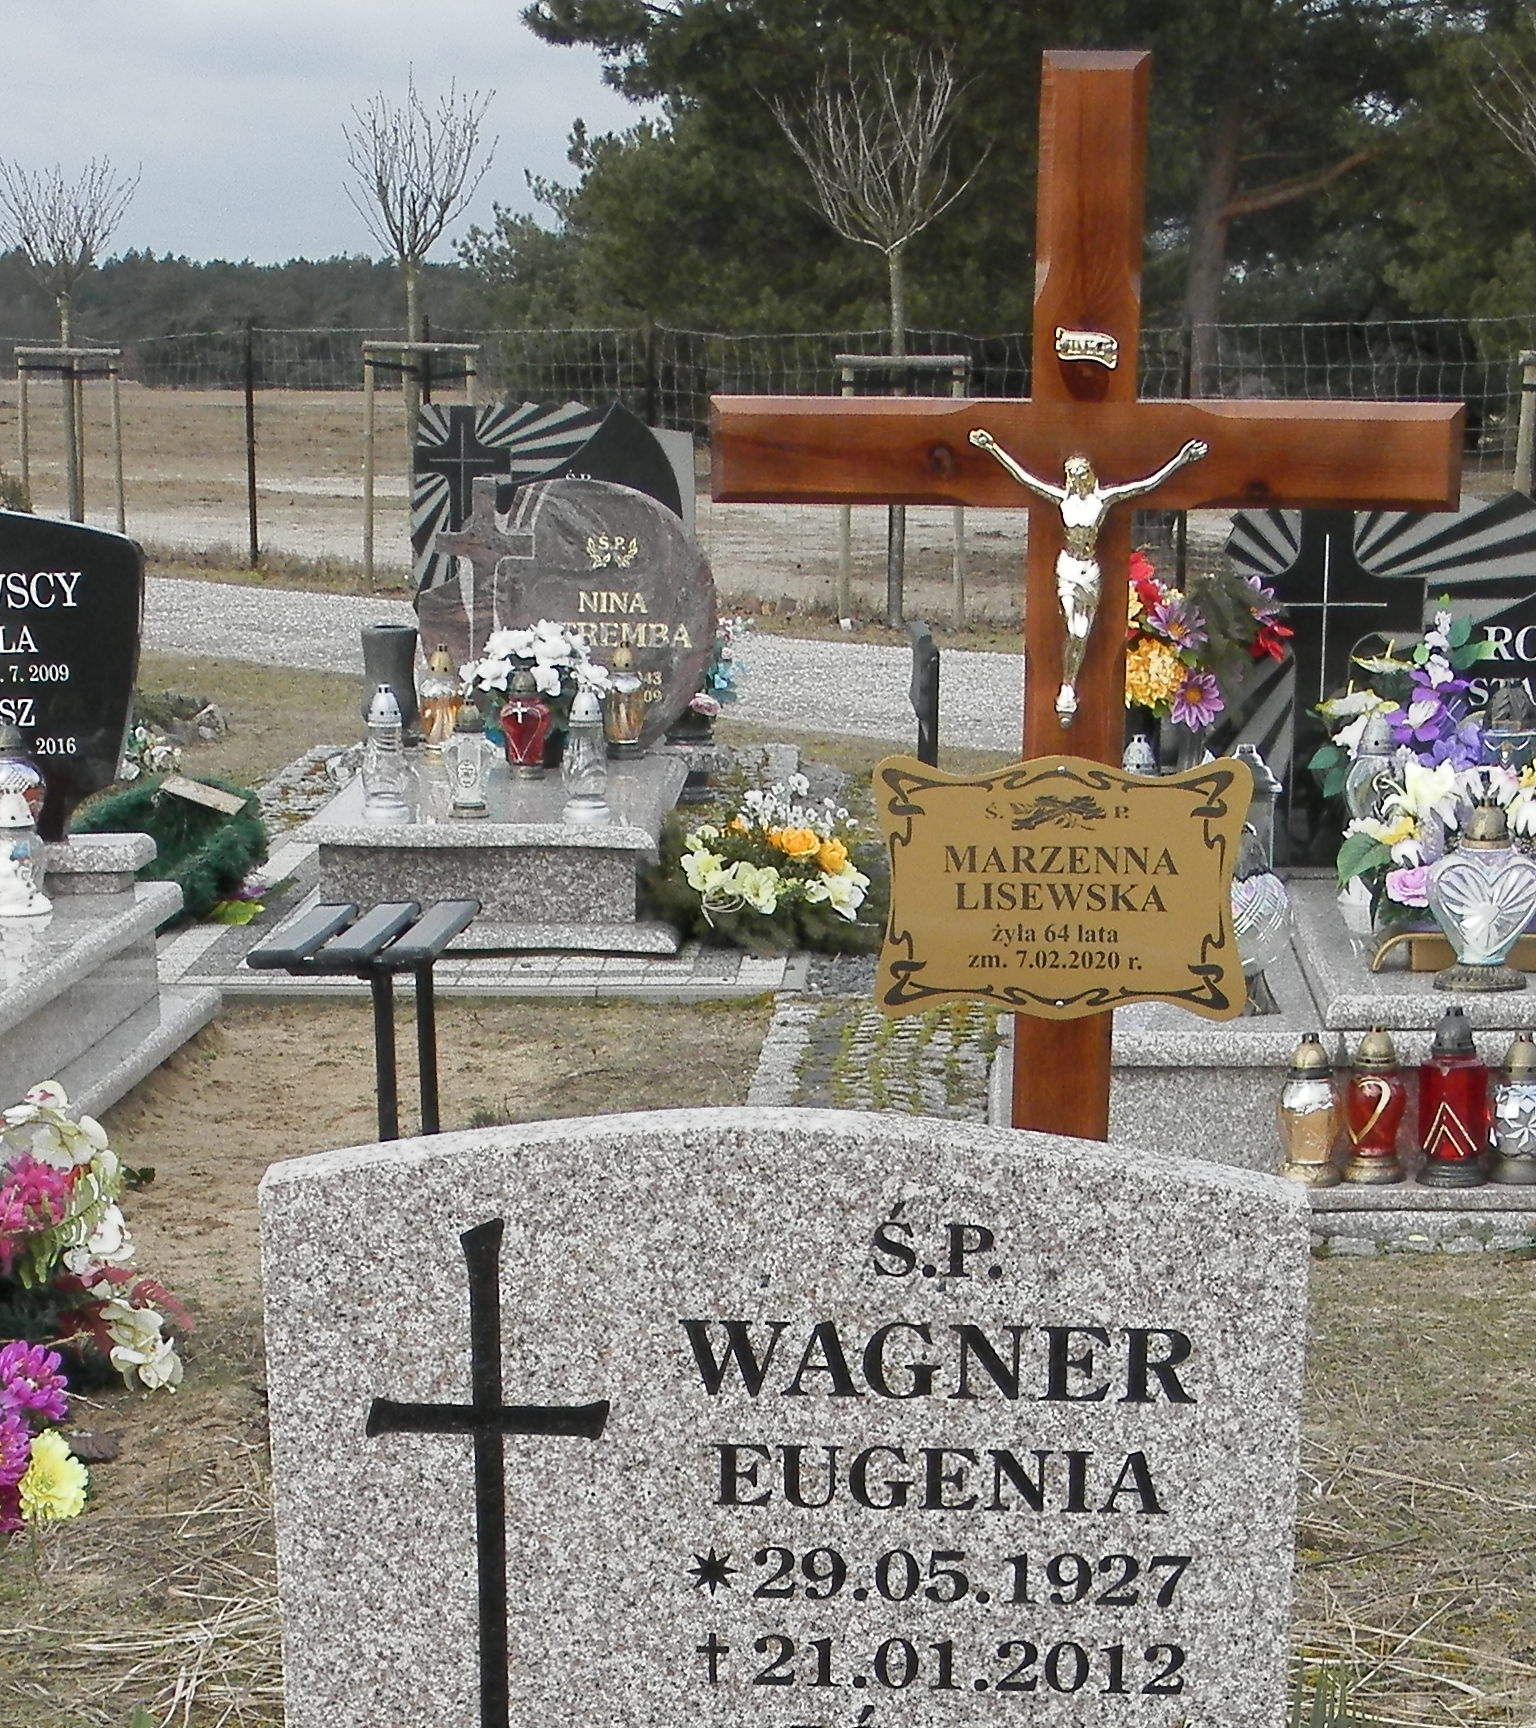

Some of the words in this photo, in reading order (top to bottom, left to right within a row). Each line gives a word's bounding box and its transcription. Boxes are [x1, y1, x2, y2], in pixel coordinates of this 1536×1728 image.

[598, 531, 627, 550] Ś.P.
[577, 591, 649, 614] NINA
[943, 845, 1180, 875] MARZENNA
[955, 882, 1168, 912] LISEWSKA
[991, 922, 1036, 948] żyła
[1044, 924, 1070, 943] 64
[1077, 924, 1119, 943] lata
[967, 953, 1007, 969] zm.
[1015, 949, 1120, 970] 7.02.2020
[1127, 955, 1143, 970] r.
[872, 1203, 1005, 1279] Ś.P.
[677, 1317, 1197, 1405] WAGNER
[712, 1442, 1169, 1516] EUGENIA
[752, 1545, 1194, 1606] 29.05.1927
[752, 1633, 1188, 1696] 21.01.2012
